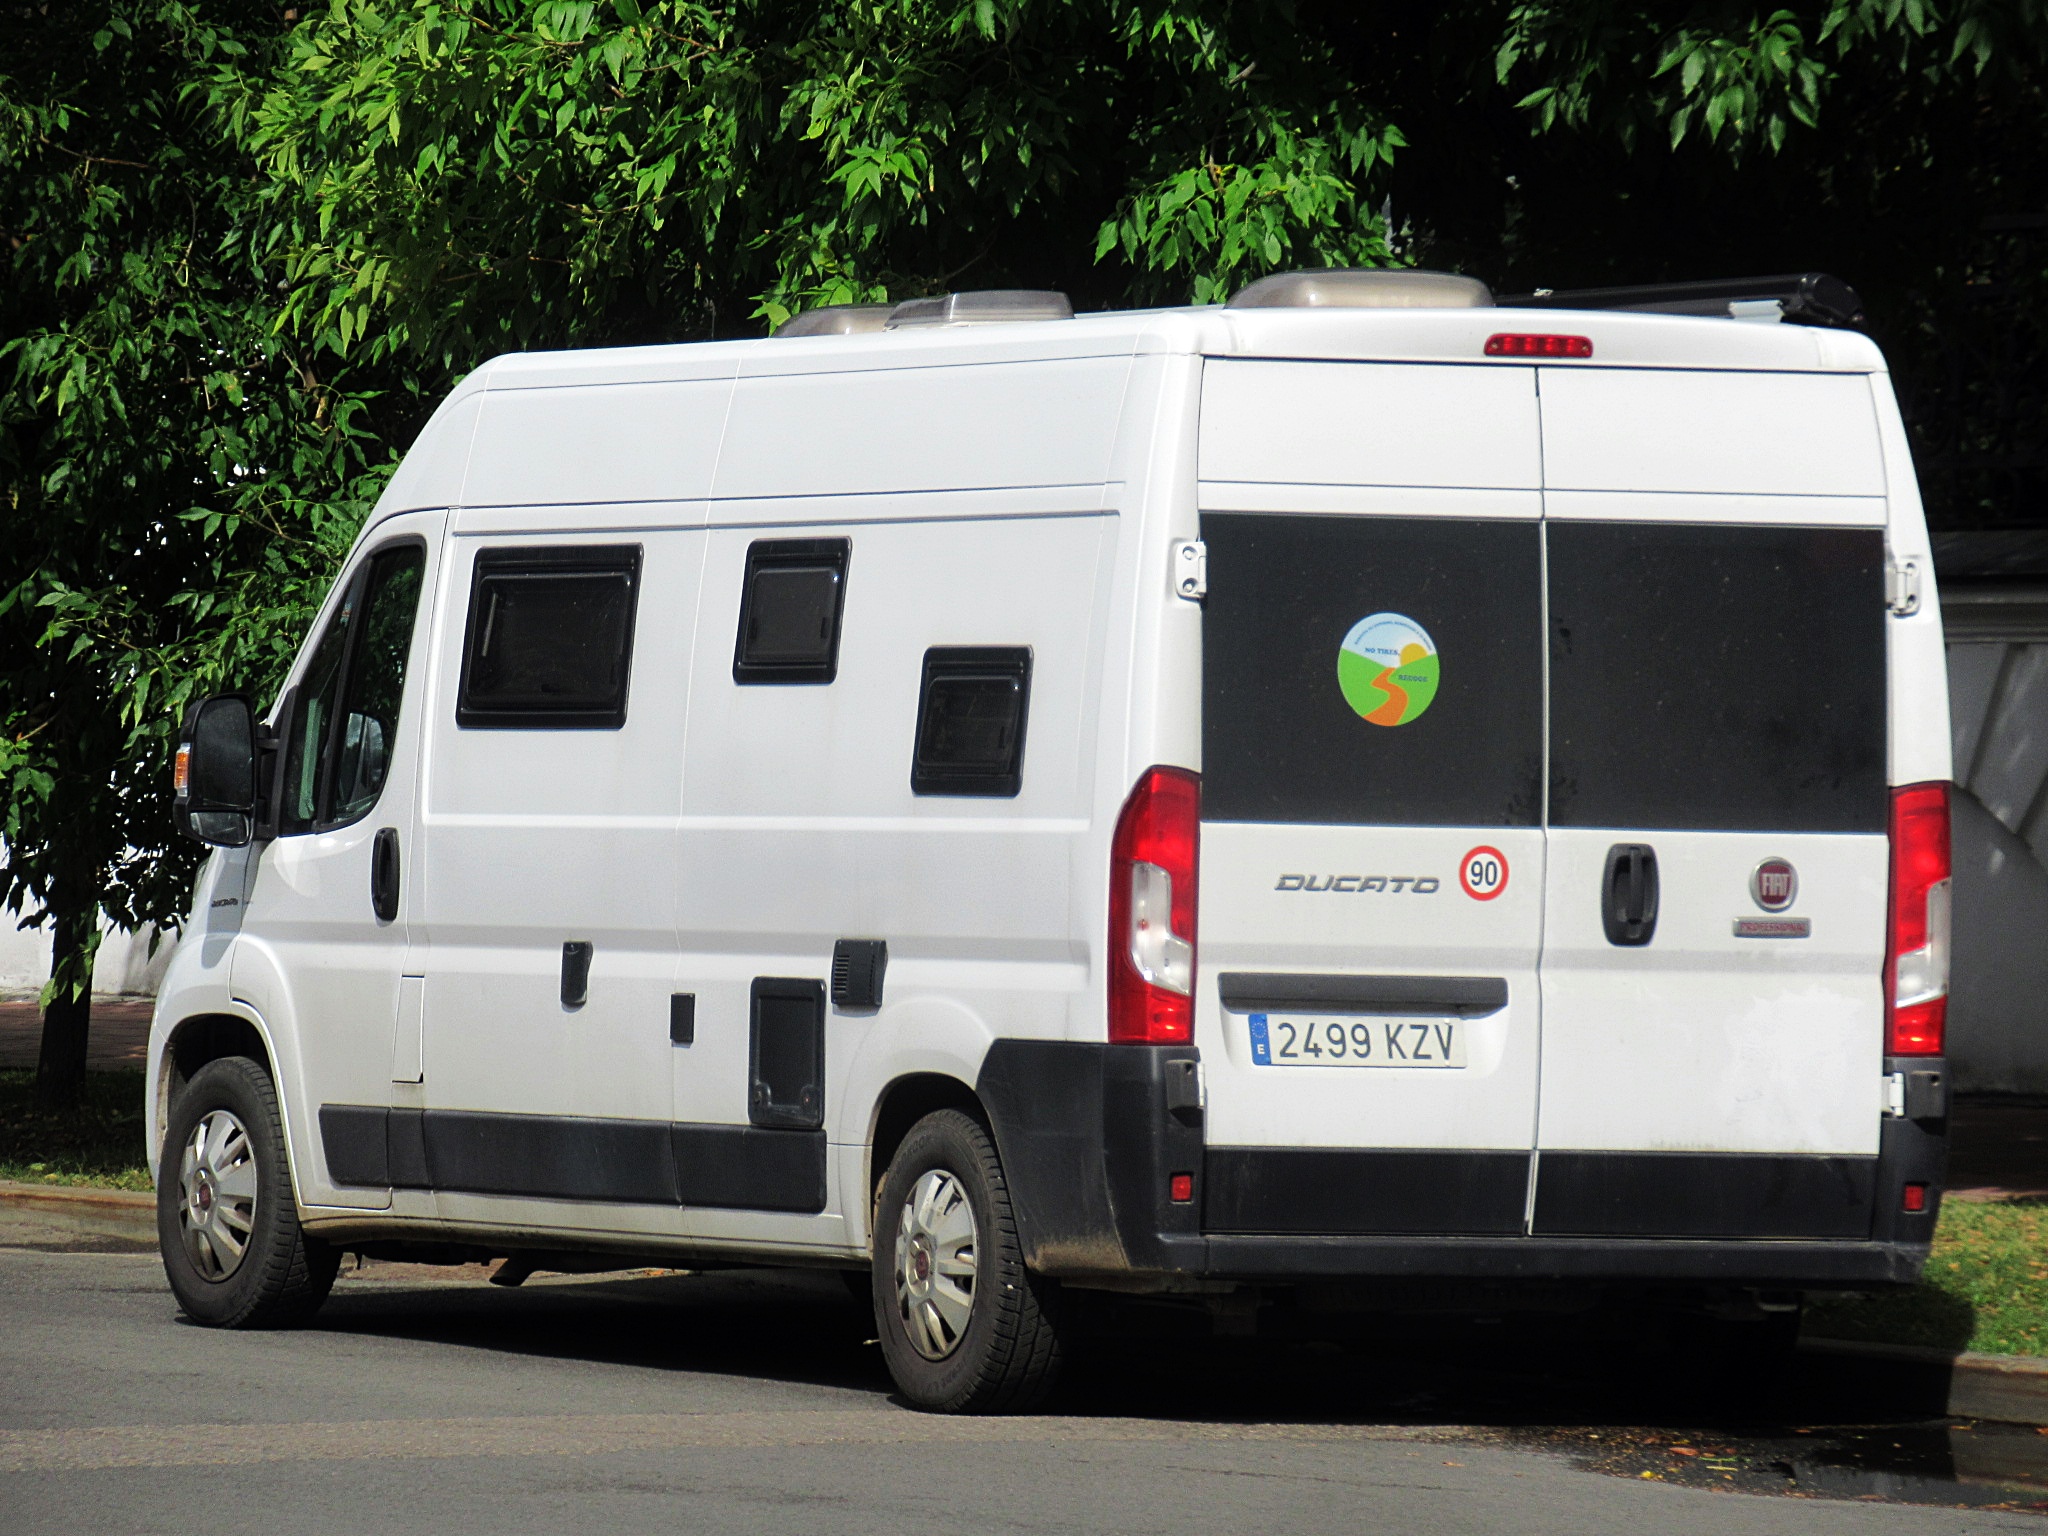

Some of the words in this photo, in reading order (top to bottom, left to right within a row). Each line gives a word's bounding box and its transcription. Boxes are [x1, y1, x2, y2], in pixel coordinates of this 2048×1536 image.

[1274, 873, 1440, 894] DUCATO
[1470, 860, 1498, 887] 90
[1761, 873, 1790, 896] FIAT
[1256, 1043, 1266, 1055] E
[1277, 1022, 1372, 1059] 2499
[1384, 1023, 1454, 1061] KZV
